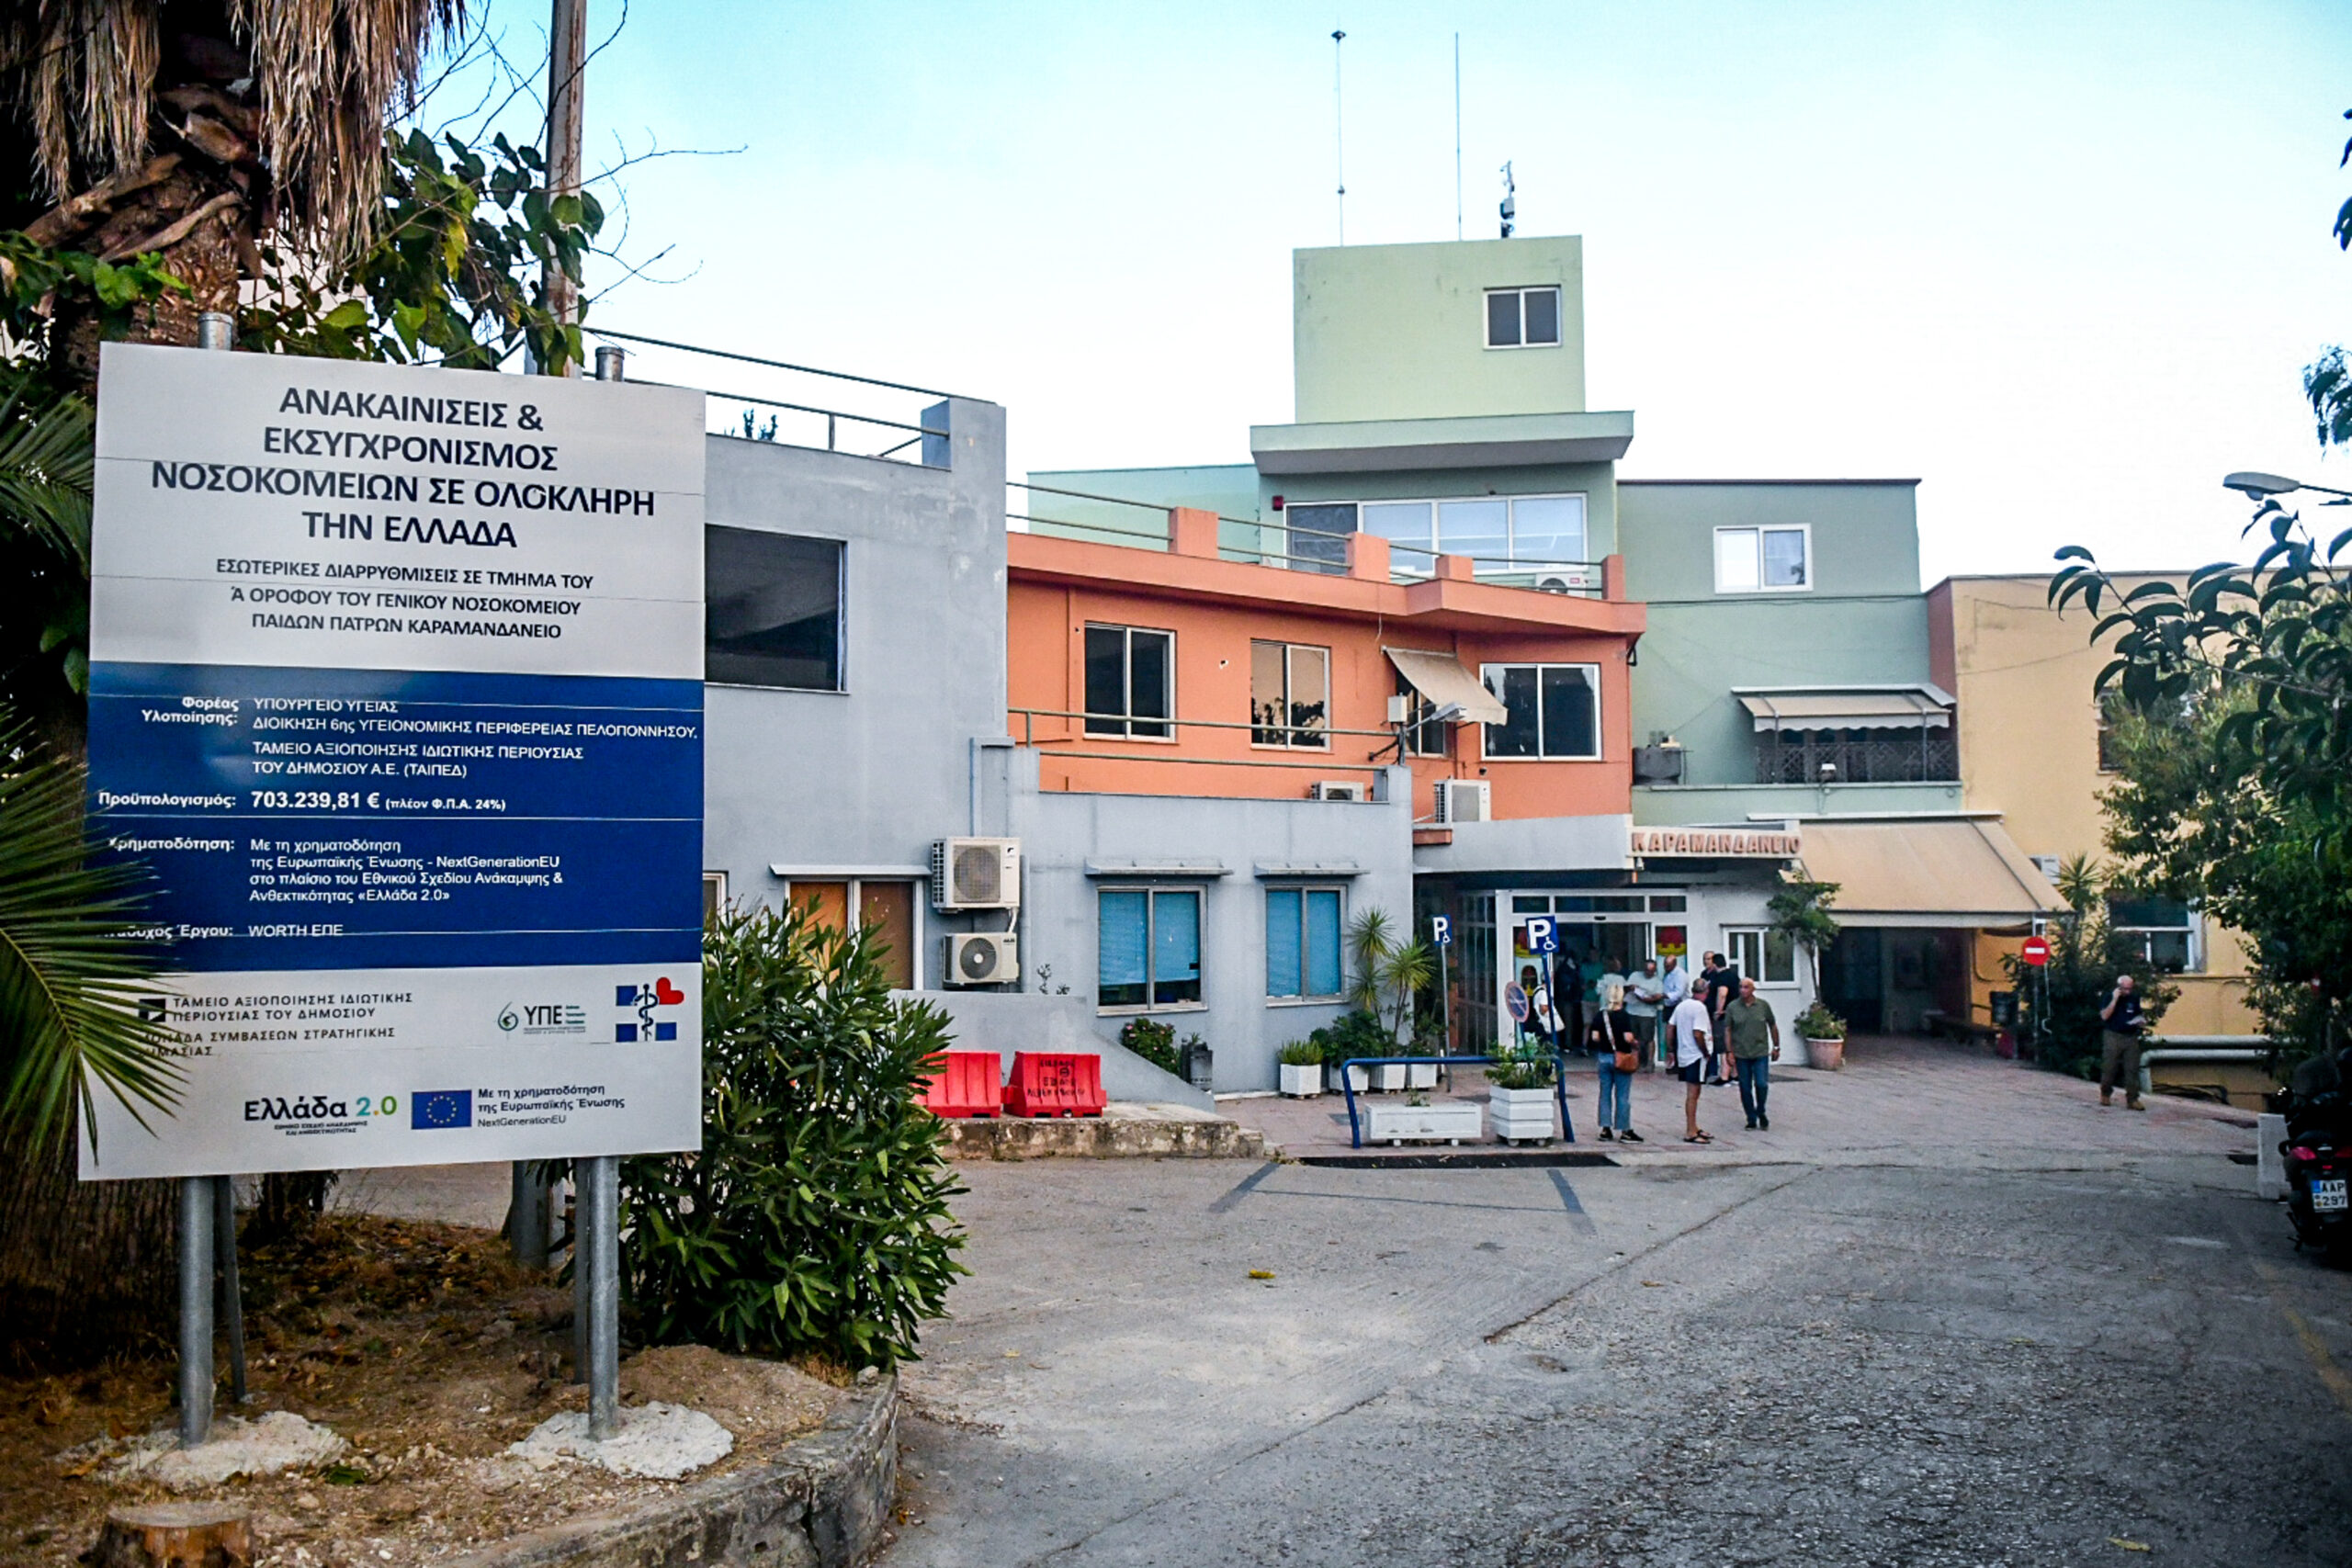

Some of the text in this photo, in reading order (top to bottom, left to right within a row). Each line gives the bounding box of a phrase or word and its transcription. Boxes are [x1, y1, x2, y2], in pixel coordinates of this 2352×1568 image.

[278, 387, 544, 432] ΑΝΑΚΑΙΝΙΣΕΙΣ &
[264, 426, 558, 471] ΕΚΣΥΓΧΡΟΝΙΣΜΟΣ
[152, 461, 654, 515] ΝΟΣΟΚΟΜΕΙΩΝ ΣΕ ΟΛΟΚΛΗΡΗ
[301, 511, 517, 547] ΤΗΝ ΕΛΛΑΔΑ
[216, 558, 594, 589] ΕΣΩΤΕΡΙΚΕΣ ΔΙΑΡΡΥΘΜΙΣΕΙΣ ΣΕ ΤΜΗΜΑ ΤΟΥ
[249, 588, 332, 605] ΟΡΟΦΟΥ
[336, 592, 371, 606] ΤΟΥ
[377, 593, 447, 610] ΓΕΝΙΚΟΥ
[452, 597, 582, 615] ΝΟΣΟΚΟΜΕΙΟΥ
[252, 613, 561, 638] ΠΑΙΔΩΝ ΠΑΤΡΩΝ ΚΑΡΑΜΑΝΔΑΝΕΙΟ
[182, 696, 239, 712] Φορέας
[254, 698, 399, 713] ΥΠΟΥΡΓΕΙΟ ΥΓΕΙΑΣ
[141, 709, 238, 727] Υλοποίησης:
[253, 716, 698, 739] ΔΙΟΙΚΗΣΗ 6ης ΥΓΕΙΟΝΟΜΙΚΗΣ ΠΕΡΙΦΕΡΕΙΑΣ ΠΕΛΟΠΟΝΝΗΣΟΥ.
[252, 741, 583, 760] ΤΑΜΕΙΟ ΑΞΙΟΠΟΙΗΣΗΣ ΙΔΙΩΤΙΚΗΣ ΠΕΡΙΟΥΣΙΑΣ
[252, 761, 468, 778] ΤΟΥ ΔΗΜΟΣΙΟΥ Α.Ε. (ΤΑΙΠΕΔ)
[251, 791, 506, 811] 703.239,81 € (πλέον Φ.Π.Α. 24%)
[250, 839, 401, 854] Με τη χρηματοδότηση
[1631, 831, 1802, 854] ΚΑΡΑΜΑΝΔΑΝΕΙΟ
[250, 858, 274, 871] της
[277, 856, 364, 871] Ευρωπαϊκής
[367, 856, 424, 871] Ένωσης
[436, 855, 560, 868] NextGenerationEU
[249, 872, 564, 886] στο πλαίσιο του Εθνικού Σχεδίου Ανάκαμψης &
[249, 888, 450, 904] Ανθεκτικότητας «Ελλάδα 2.0»
[248, 924, 344, 938] WORTH ΕΠΕ
[1433, 917, 1449, 942] P
[1527, 919, 1552, 949] P
[173, 992, 413, 1008] ΤΑΜΕΙΟ ΑΞΙΟΠΟΙΗΣΗΣ ΙΔΙΩΤΙΚΗΣ
[173, 1008, 376, 1021] ΠΕΡΙΟΥΣΙΑΣ ΤΟΥ ΔΗΜΟΣΙΟΥ
[524, 1005, 562, 1026] ΥΠΕ
[209, 1030, 298, 1043] ΣΥΜΒΑΣΕΩΝ
[303, 1027, 396, 1041] ΣΤΡΑΤΗΓΙΚΗΣ
[478, 1085, 605, 1100] Με τη χρηματοδότηση
[244, 1095, 398, 1122] Ελλάδα 2.0
[478, 1098, 626, 1114] της Ευρωπαϊκής Ένωσης
[478, 1115, 567, 1128] NextGenerationEU
[2322, 1195, 2346, 1206] 297
